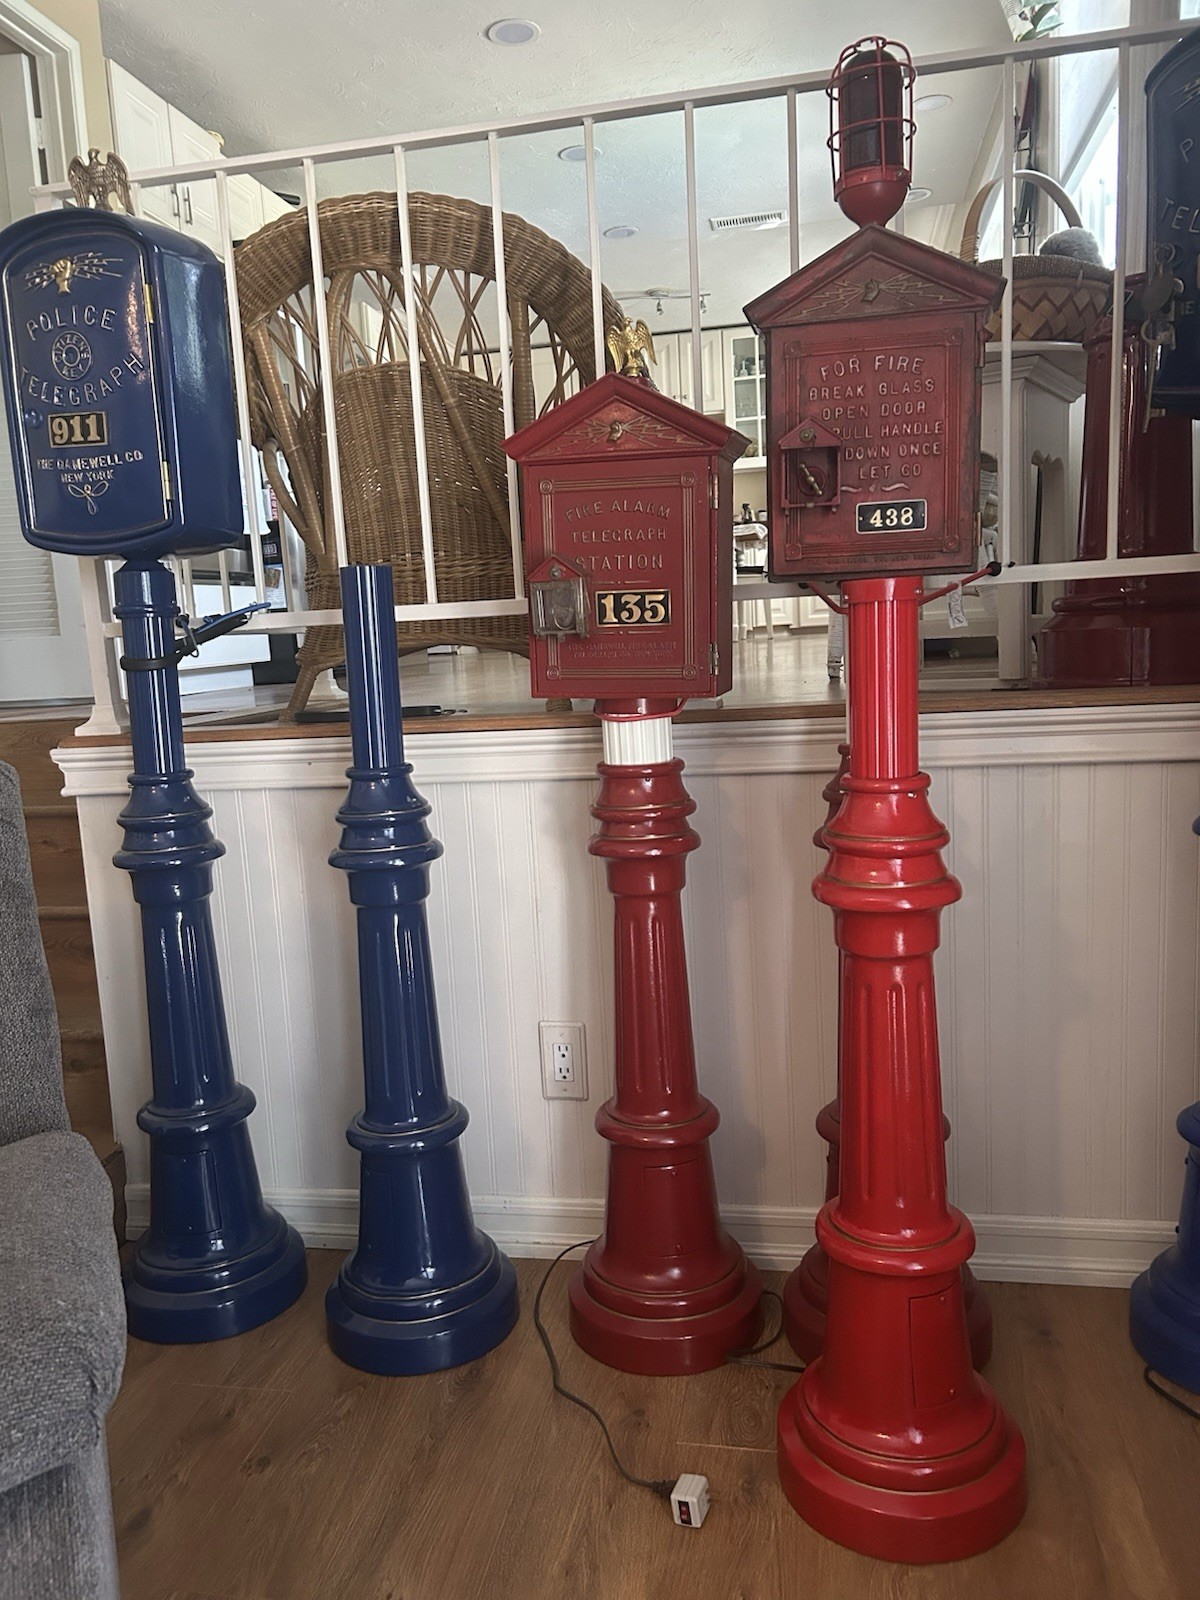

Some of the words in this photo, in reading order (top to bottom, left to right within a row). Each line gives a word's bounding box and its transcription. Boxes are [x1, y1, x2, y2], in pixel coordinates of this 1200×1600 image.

[26, 305, 117, 341] POLICE
[821, 356, 860, 382] FOR
[875, 355, 925, 375] FIRE
[21, 353, 144, 406] TELEGRAPH
[809, 384, 865, 401] BREAK
[879, 379, 935, 396] GLASS
[823, 405, 869, 421] OPEN
[881, 401, 926, 417] DOOR
[52, 415, 101, 444] 911
[881, 421, 944, 438] HANDLE
[845, 444, 890, 461] DOWN
[899, 442, 942, 457] ONCE
[36, 459, 53, 470] THE
[57, 454, 123, 470] GAMEWELL
[859, 465, 891, 480] LET
[902, 463, 922, 477] GO
[61, 473, 83, 483] NEW
[86, 469, 114, 482] YORK
[565, 501, 603, 523] FIRE
[611, 500, 671, 520] ALARM
[869, 507, 914, 528] 438
[571, 528, 667, 544] TELEGRAPH
[575, 554, 663, 571] STATION
[601, 594, 666, 623] 135
